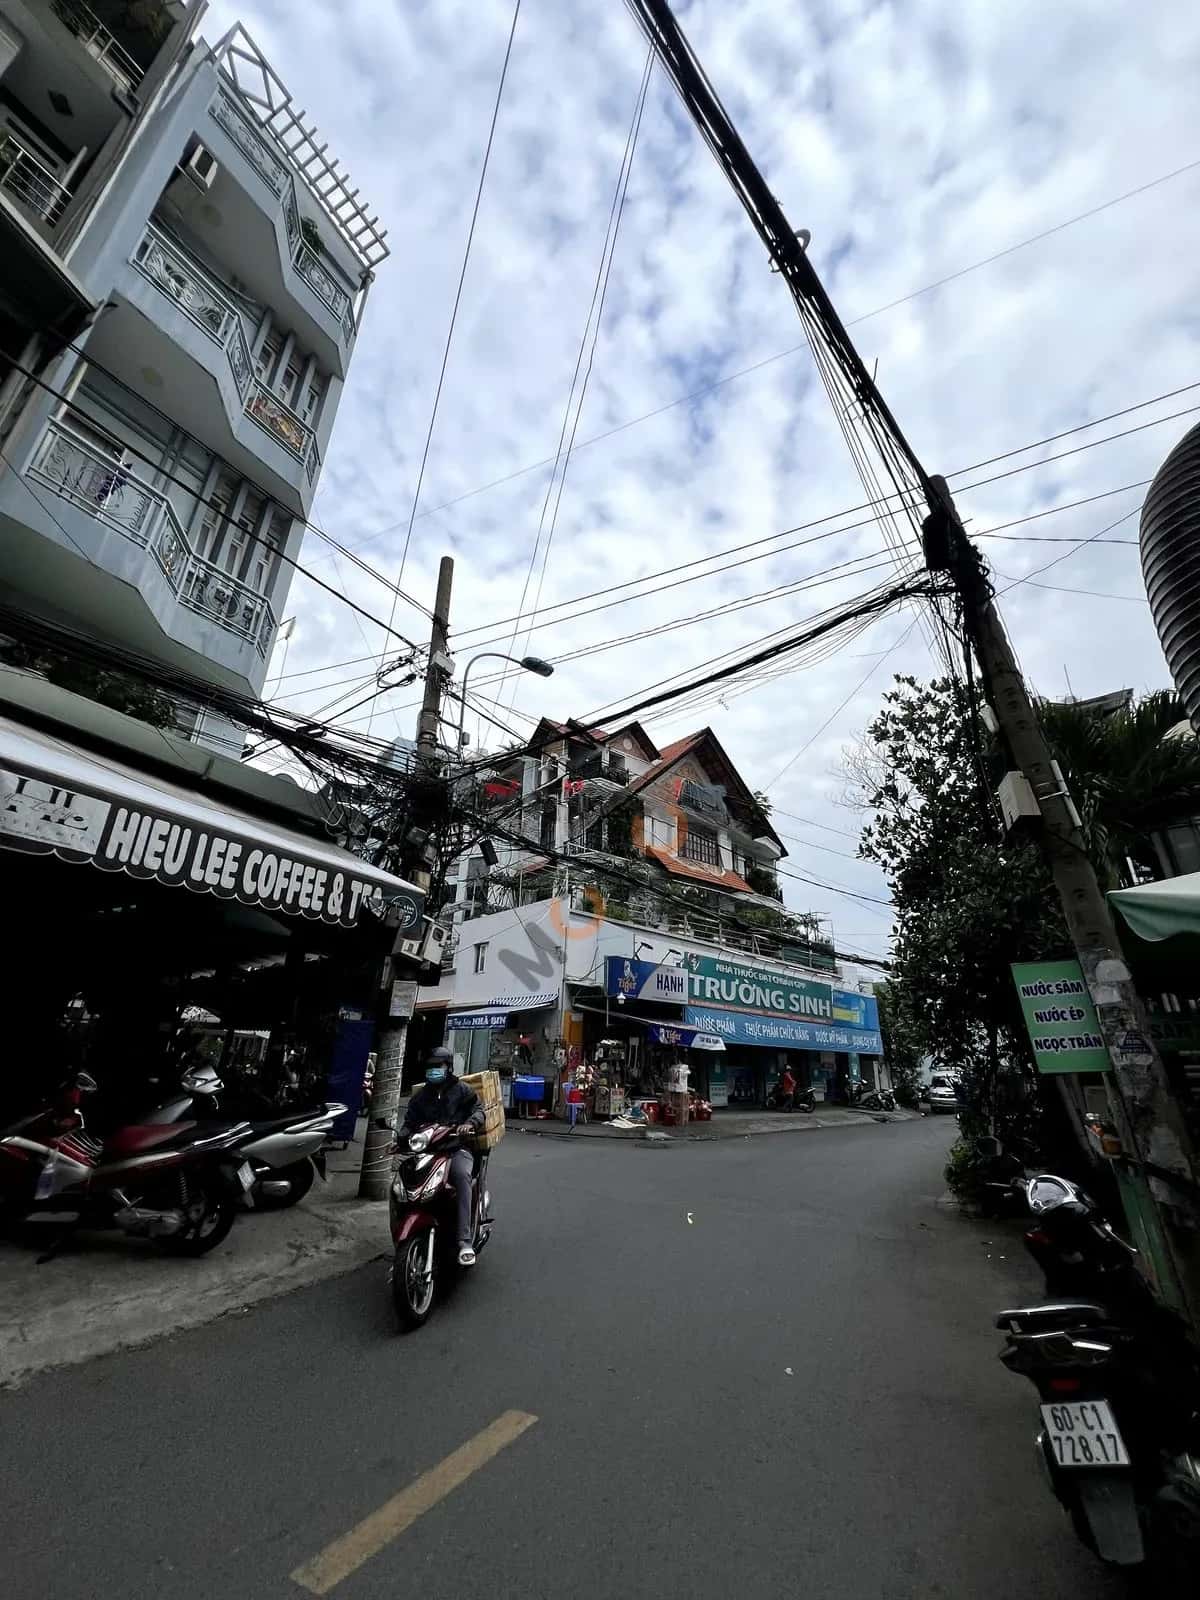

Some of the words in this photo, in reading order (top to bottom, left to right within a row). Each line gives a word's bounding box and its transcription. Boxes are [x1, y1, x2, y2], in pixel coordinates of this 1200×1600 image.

[105, 807, 192, 875] HIEU
[190, 833, 242, 889] LEE
[242, 849, 328, 912] COFFEE
[327, 872, 345, 917] &
[689, 973, 785, 1011] TRƯỜNG
[789, 994, 831, 1017] SINH
[1021, 979, 1053, 997] NƯỚC
[1056, 980, 1083, 994] SÂM
[1034, 1006, 1067, 1023] NƯỚC
[1069, 1006, 1085, 1021] ÉP
[1034, 1037, 1067, 1053] NGỌC
[1053, 1434, 1119, 1463] 728.17
